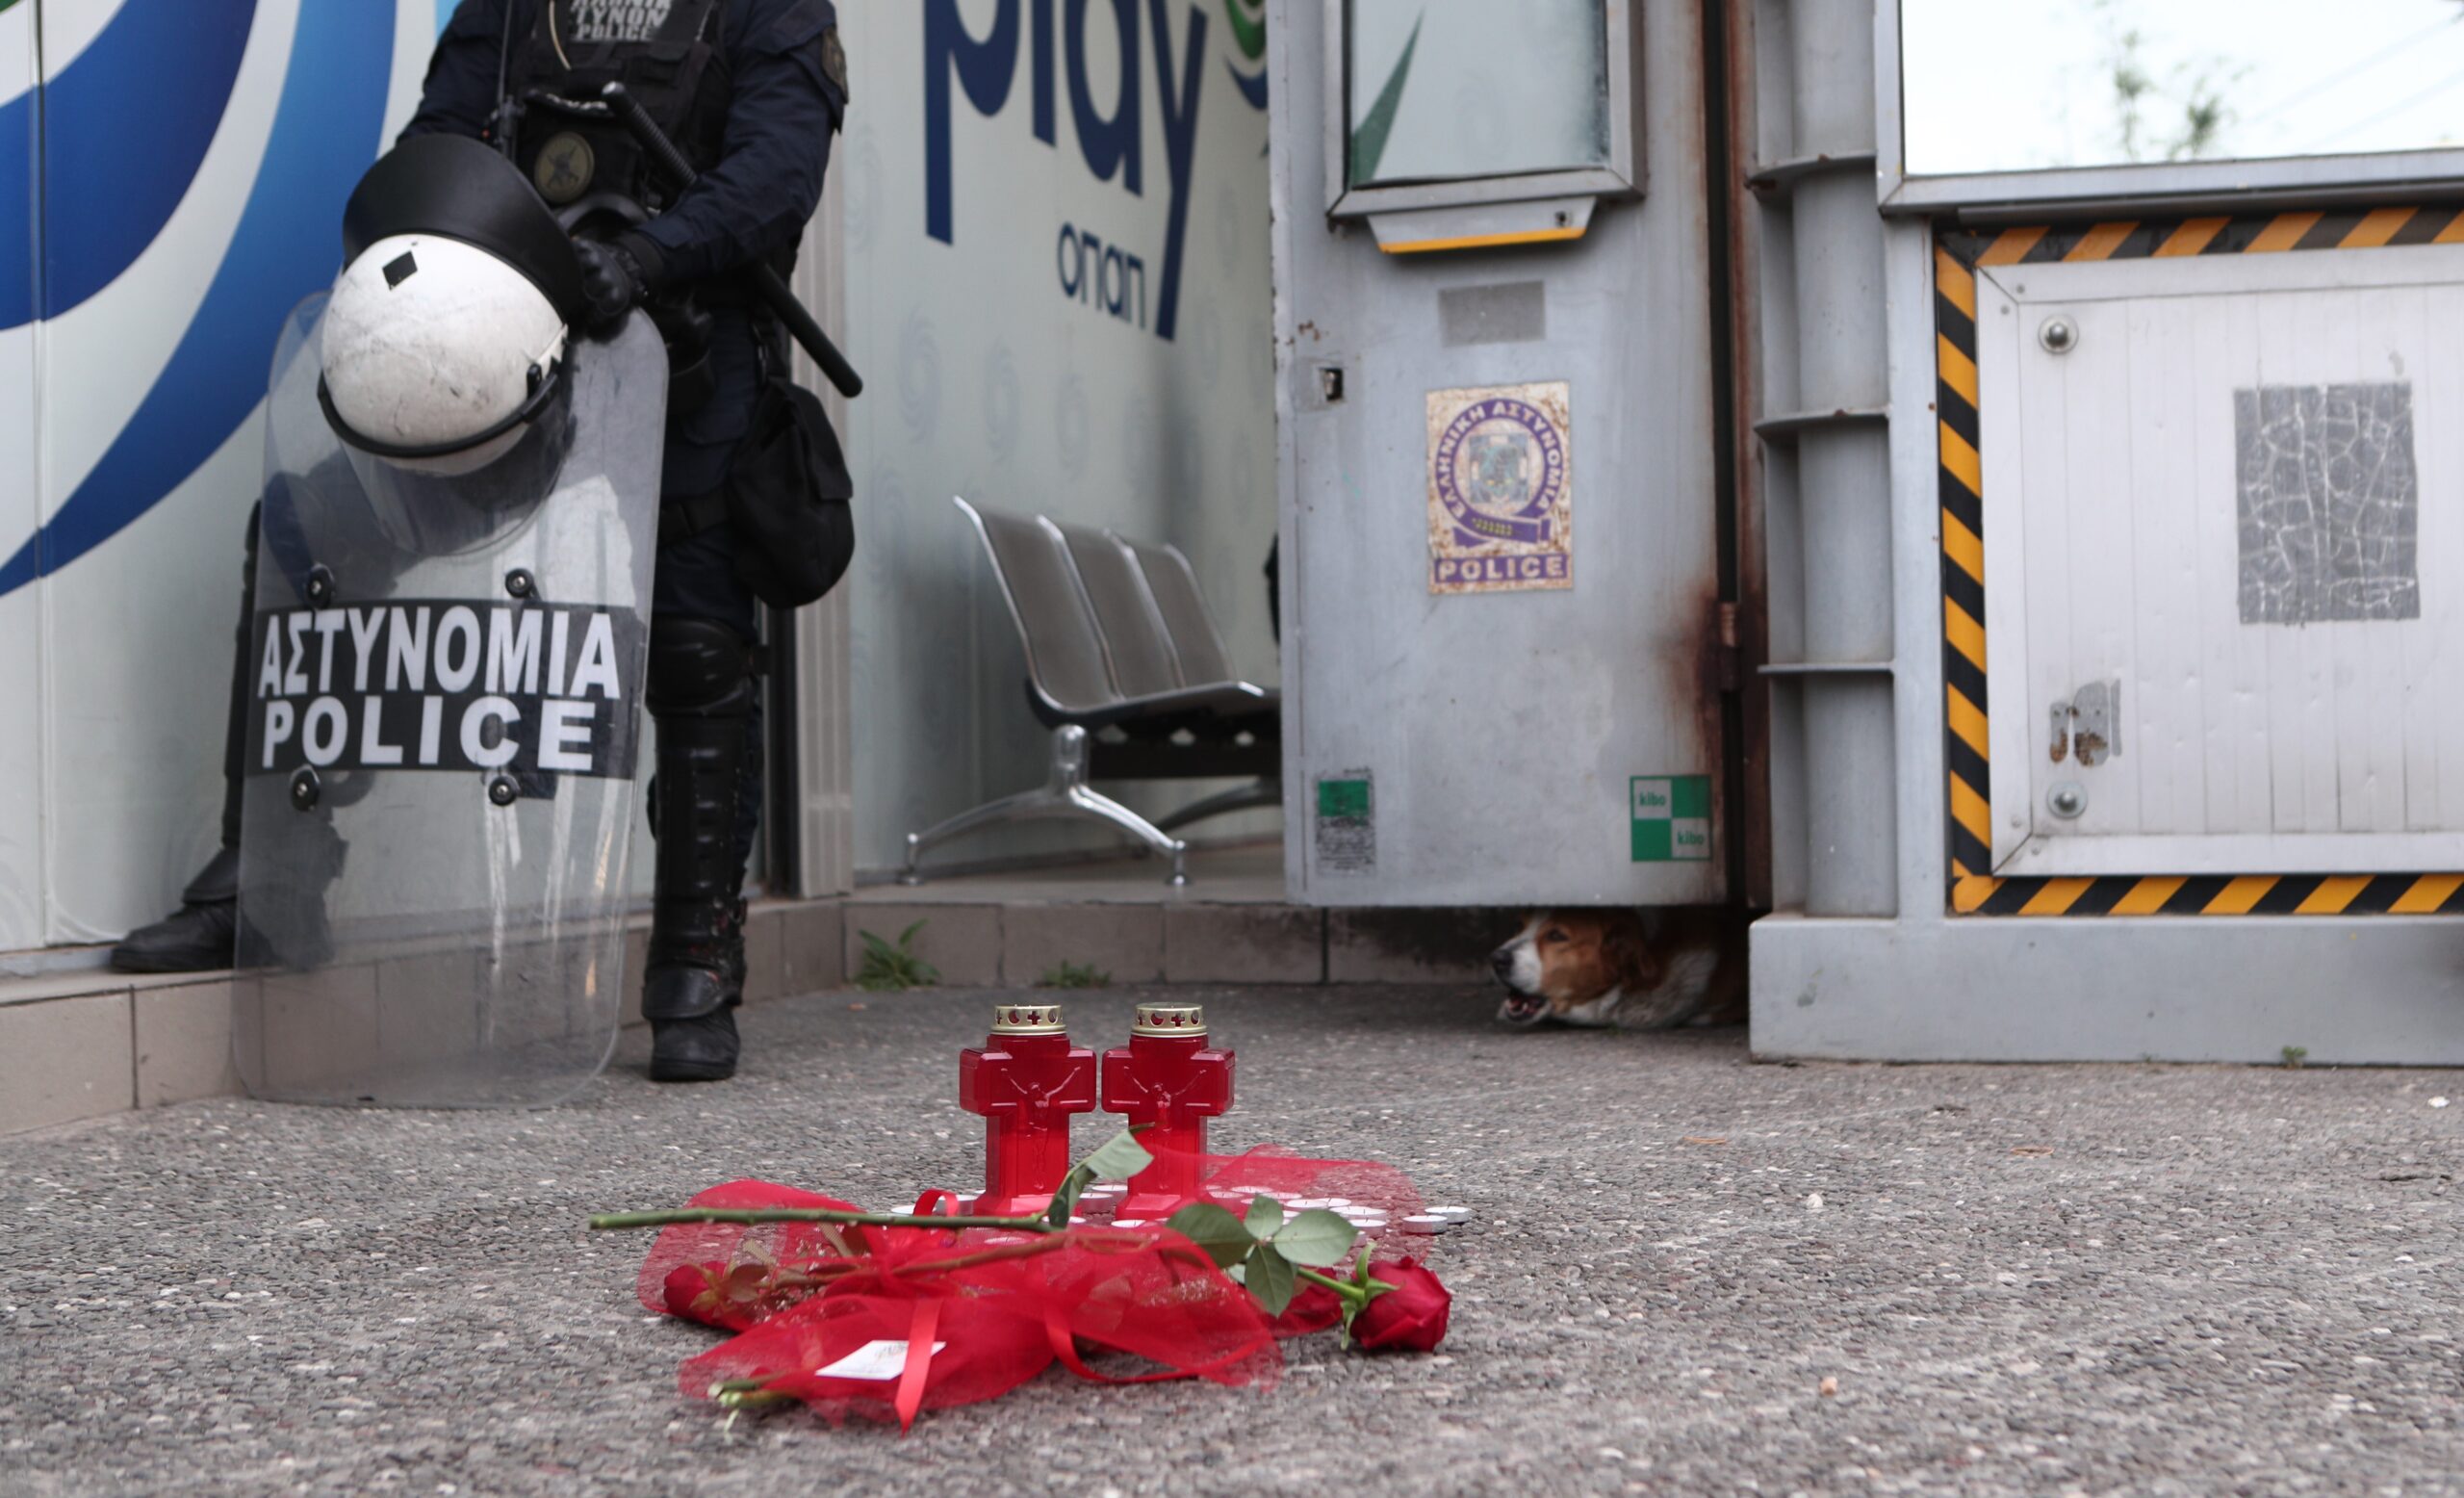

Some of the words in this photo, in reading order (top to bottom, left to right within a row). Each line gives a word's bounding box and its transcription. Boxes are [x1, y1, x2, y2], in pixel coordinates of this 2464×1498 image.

[1493, 401, 1562, 511] ΑΣΤΥΝΟΜΙΑ
[1438, 555, 1564, 581] POLICE
[258, 606, 621, 700] ΑΣΤΥΝΟΜΙΑ
[262, 695, 597, 770] POLICE
[1639, 791, 1667, 807] kibo
[1677, 830, 1706, 845] kibo
